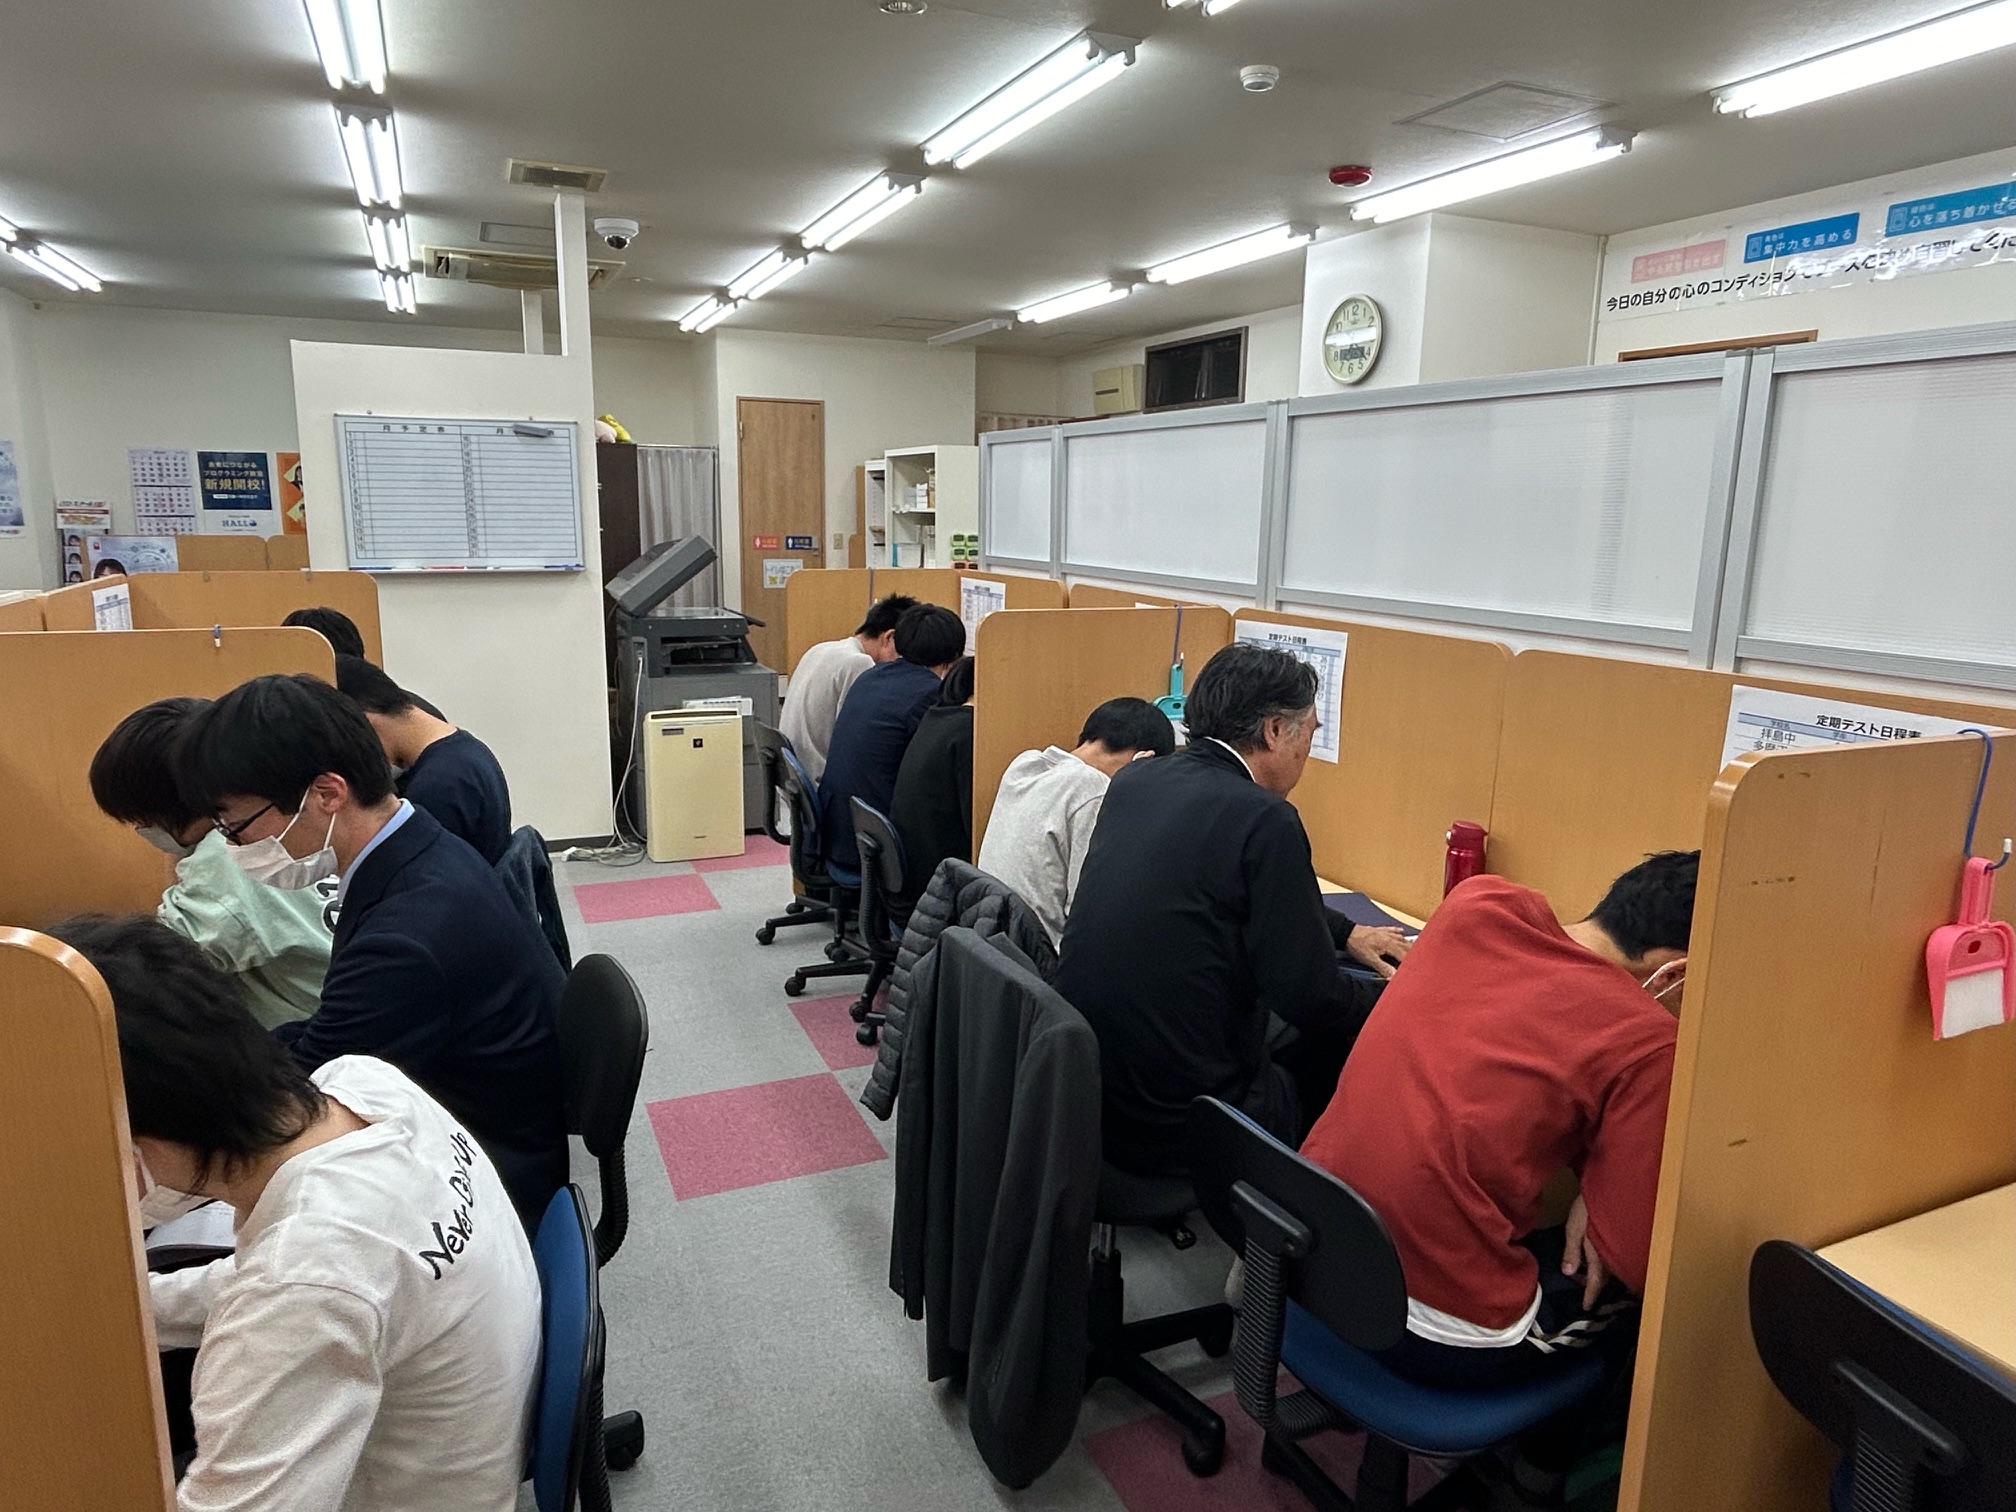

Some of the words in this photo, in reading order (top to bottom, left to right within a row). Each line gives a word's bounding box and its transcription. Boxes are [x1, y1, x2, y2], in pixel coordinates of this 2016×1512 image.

[1763, 229, 1852, 255] 集中力を高める
[1761, 727, 1796, 745] 拝島中
[1815, 714, 1922, 740] 定期テスト日程表
[418, 1204, 474, 1281] Never
